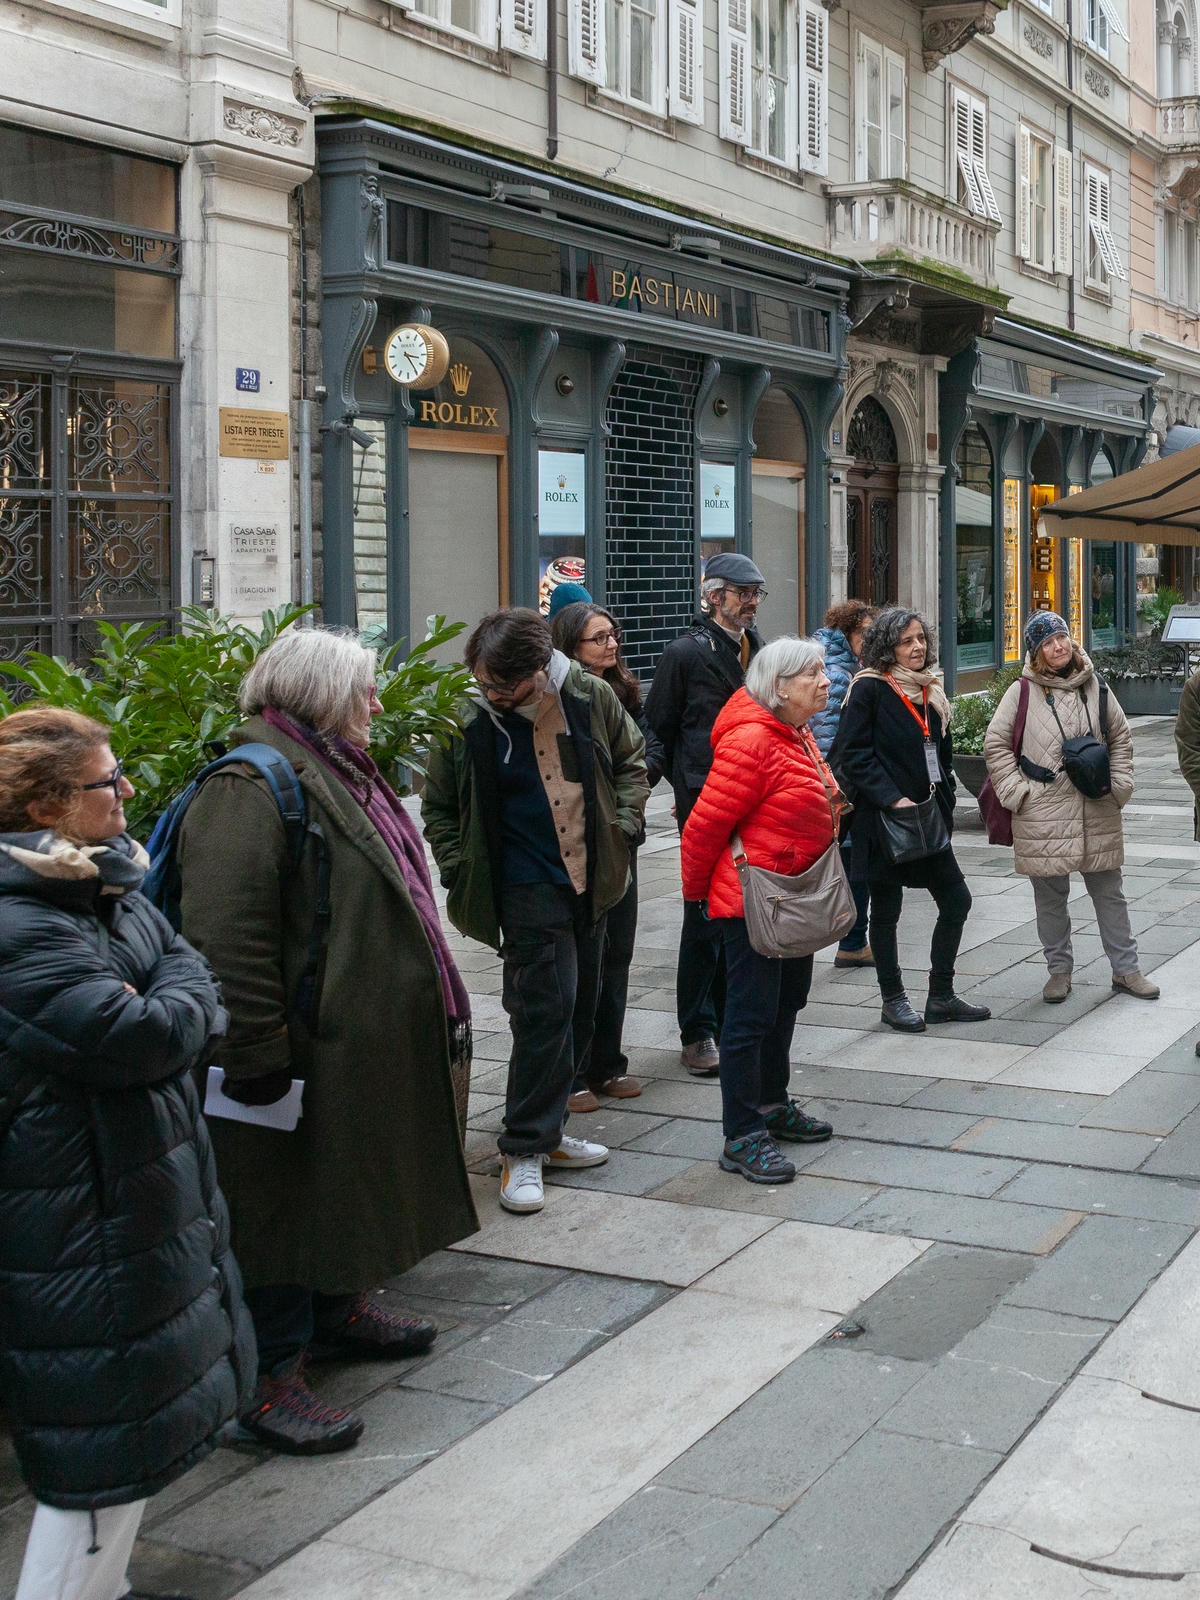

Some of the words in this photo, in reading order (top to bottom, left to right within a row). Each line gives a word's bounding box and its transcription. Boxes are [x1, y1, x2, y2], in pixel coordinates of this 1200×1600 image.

[611, 270, 717, 318] BASTIANI
[242, 370, 256, 384] 29
[420, 400, 499, 427] ROLEX
[224, 425, 243, 435] LISTA
[244, 426, 257, 436] PER
[258, 427, 284, 438] TRIESTE
[545, 491, 578, 502] ROLEX
[704, 499, 730, 509] ROLEX
[233, 526, 255, 536] CASA
[255, 526, 277, 536] SABA
[234, 537, 276, 546] TRIESTE
